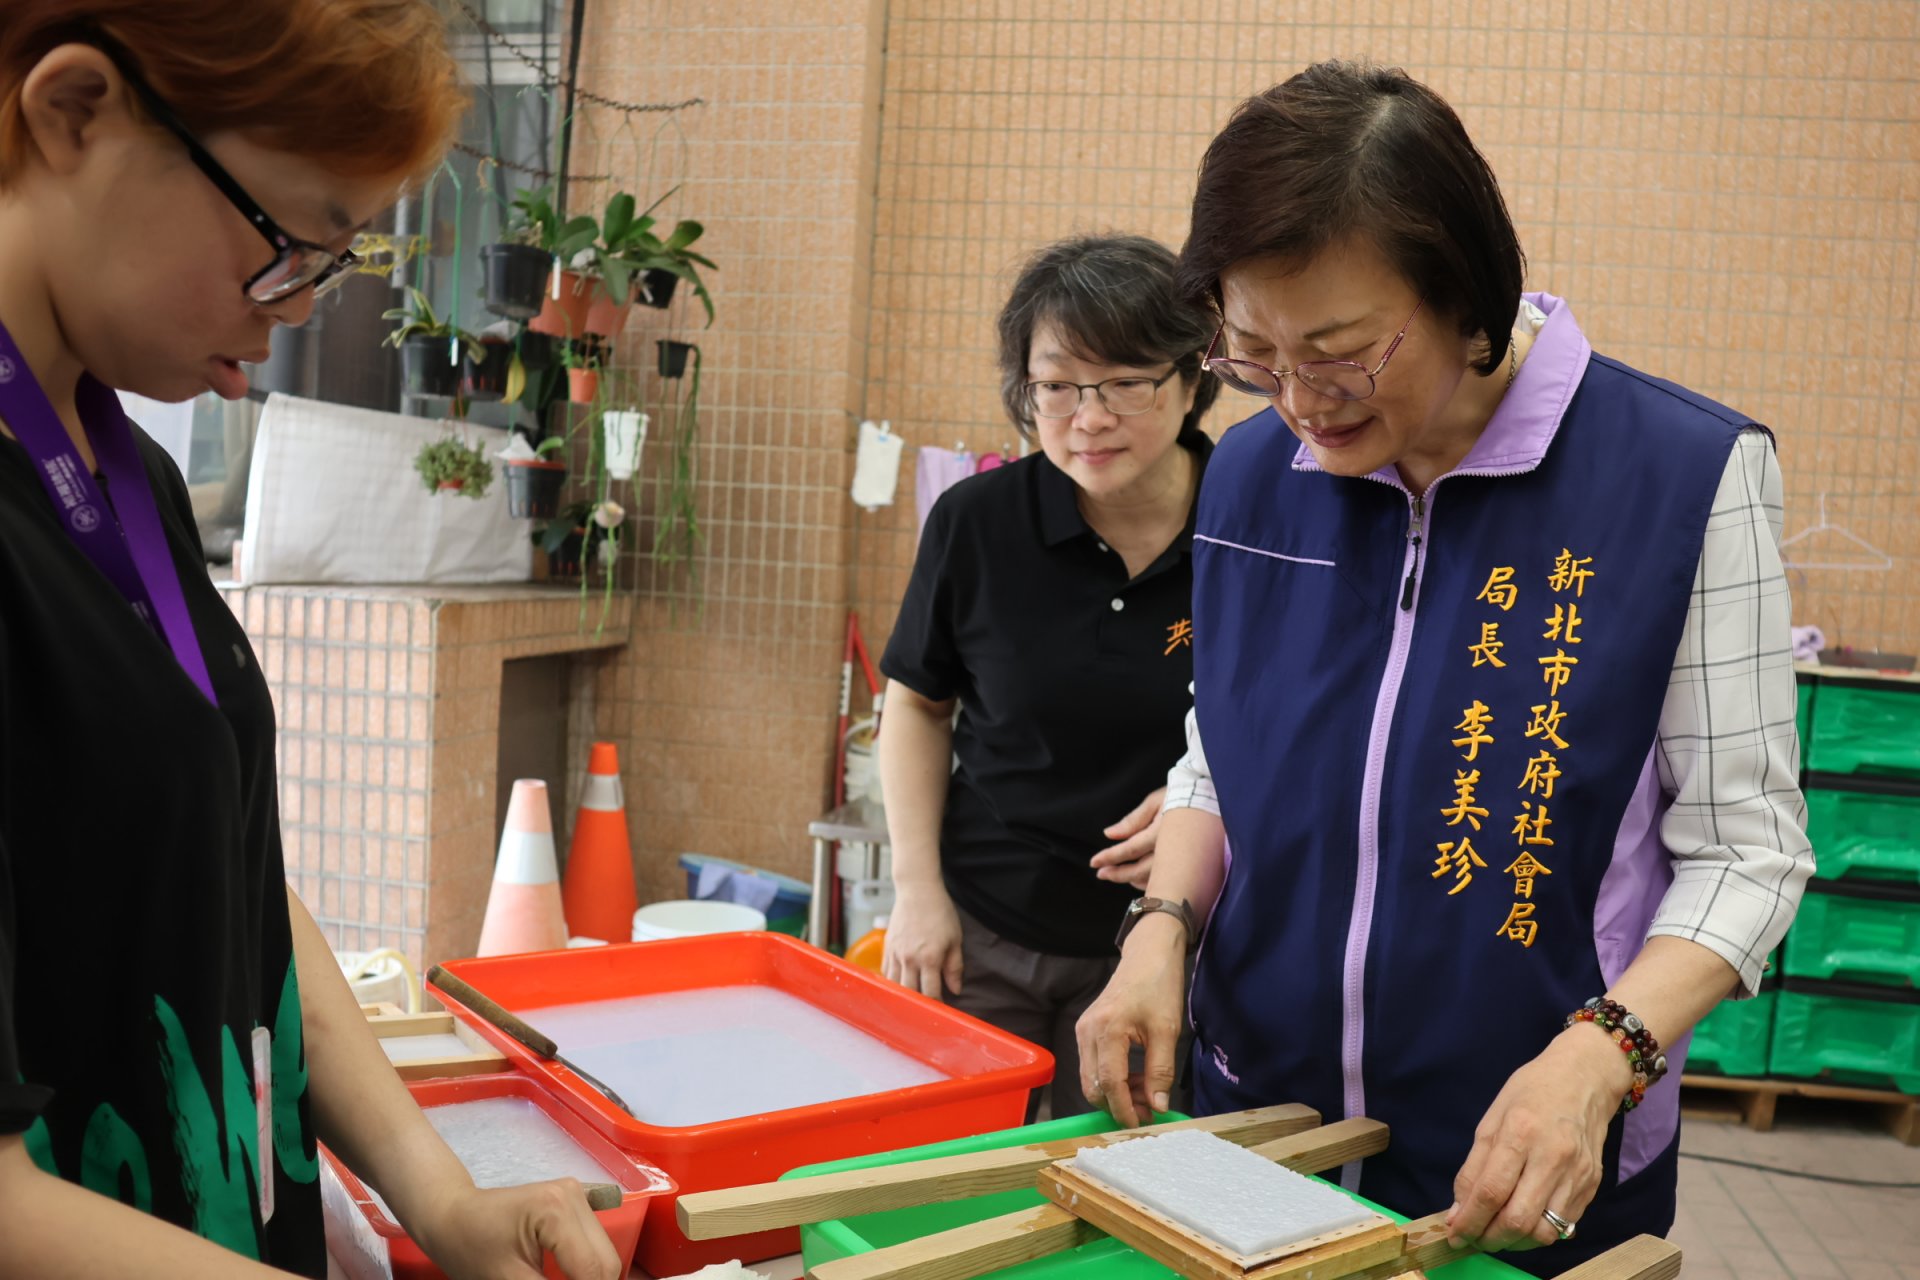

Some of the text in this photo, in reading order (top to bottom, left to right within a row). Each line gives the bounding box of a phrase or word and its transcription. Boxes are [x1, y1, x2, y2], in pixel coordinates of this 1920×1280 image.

[1165, 620, 1192, 655] 共
[1432, 567, 1517, 895] 局長 李美珍
[1497, 549, 1595, 947] 新北市政府社會局
